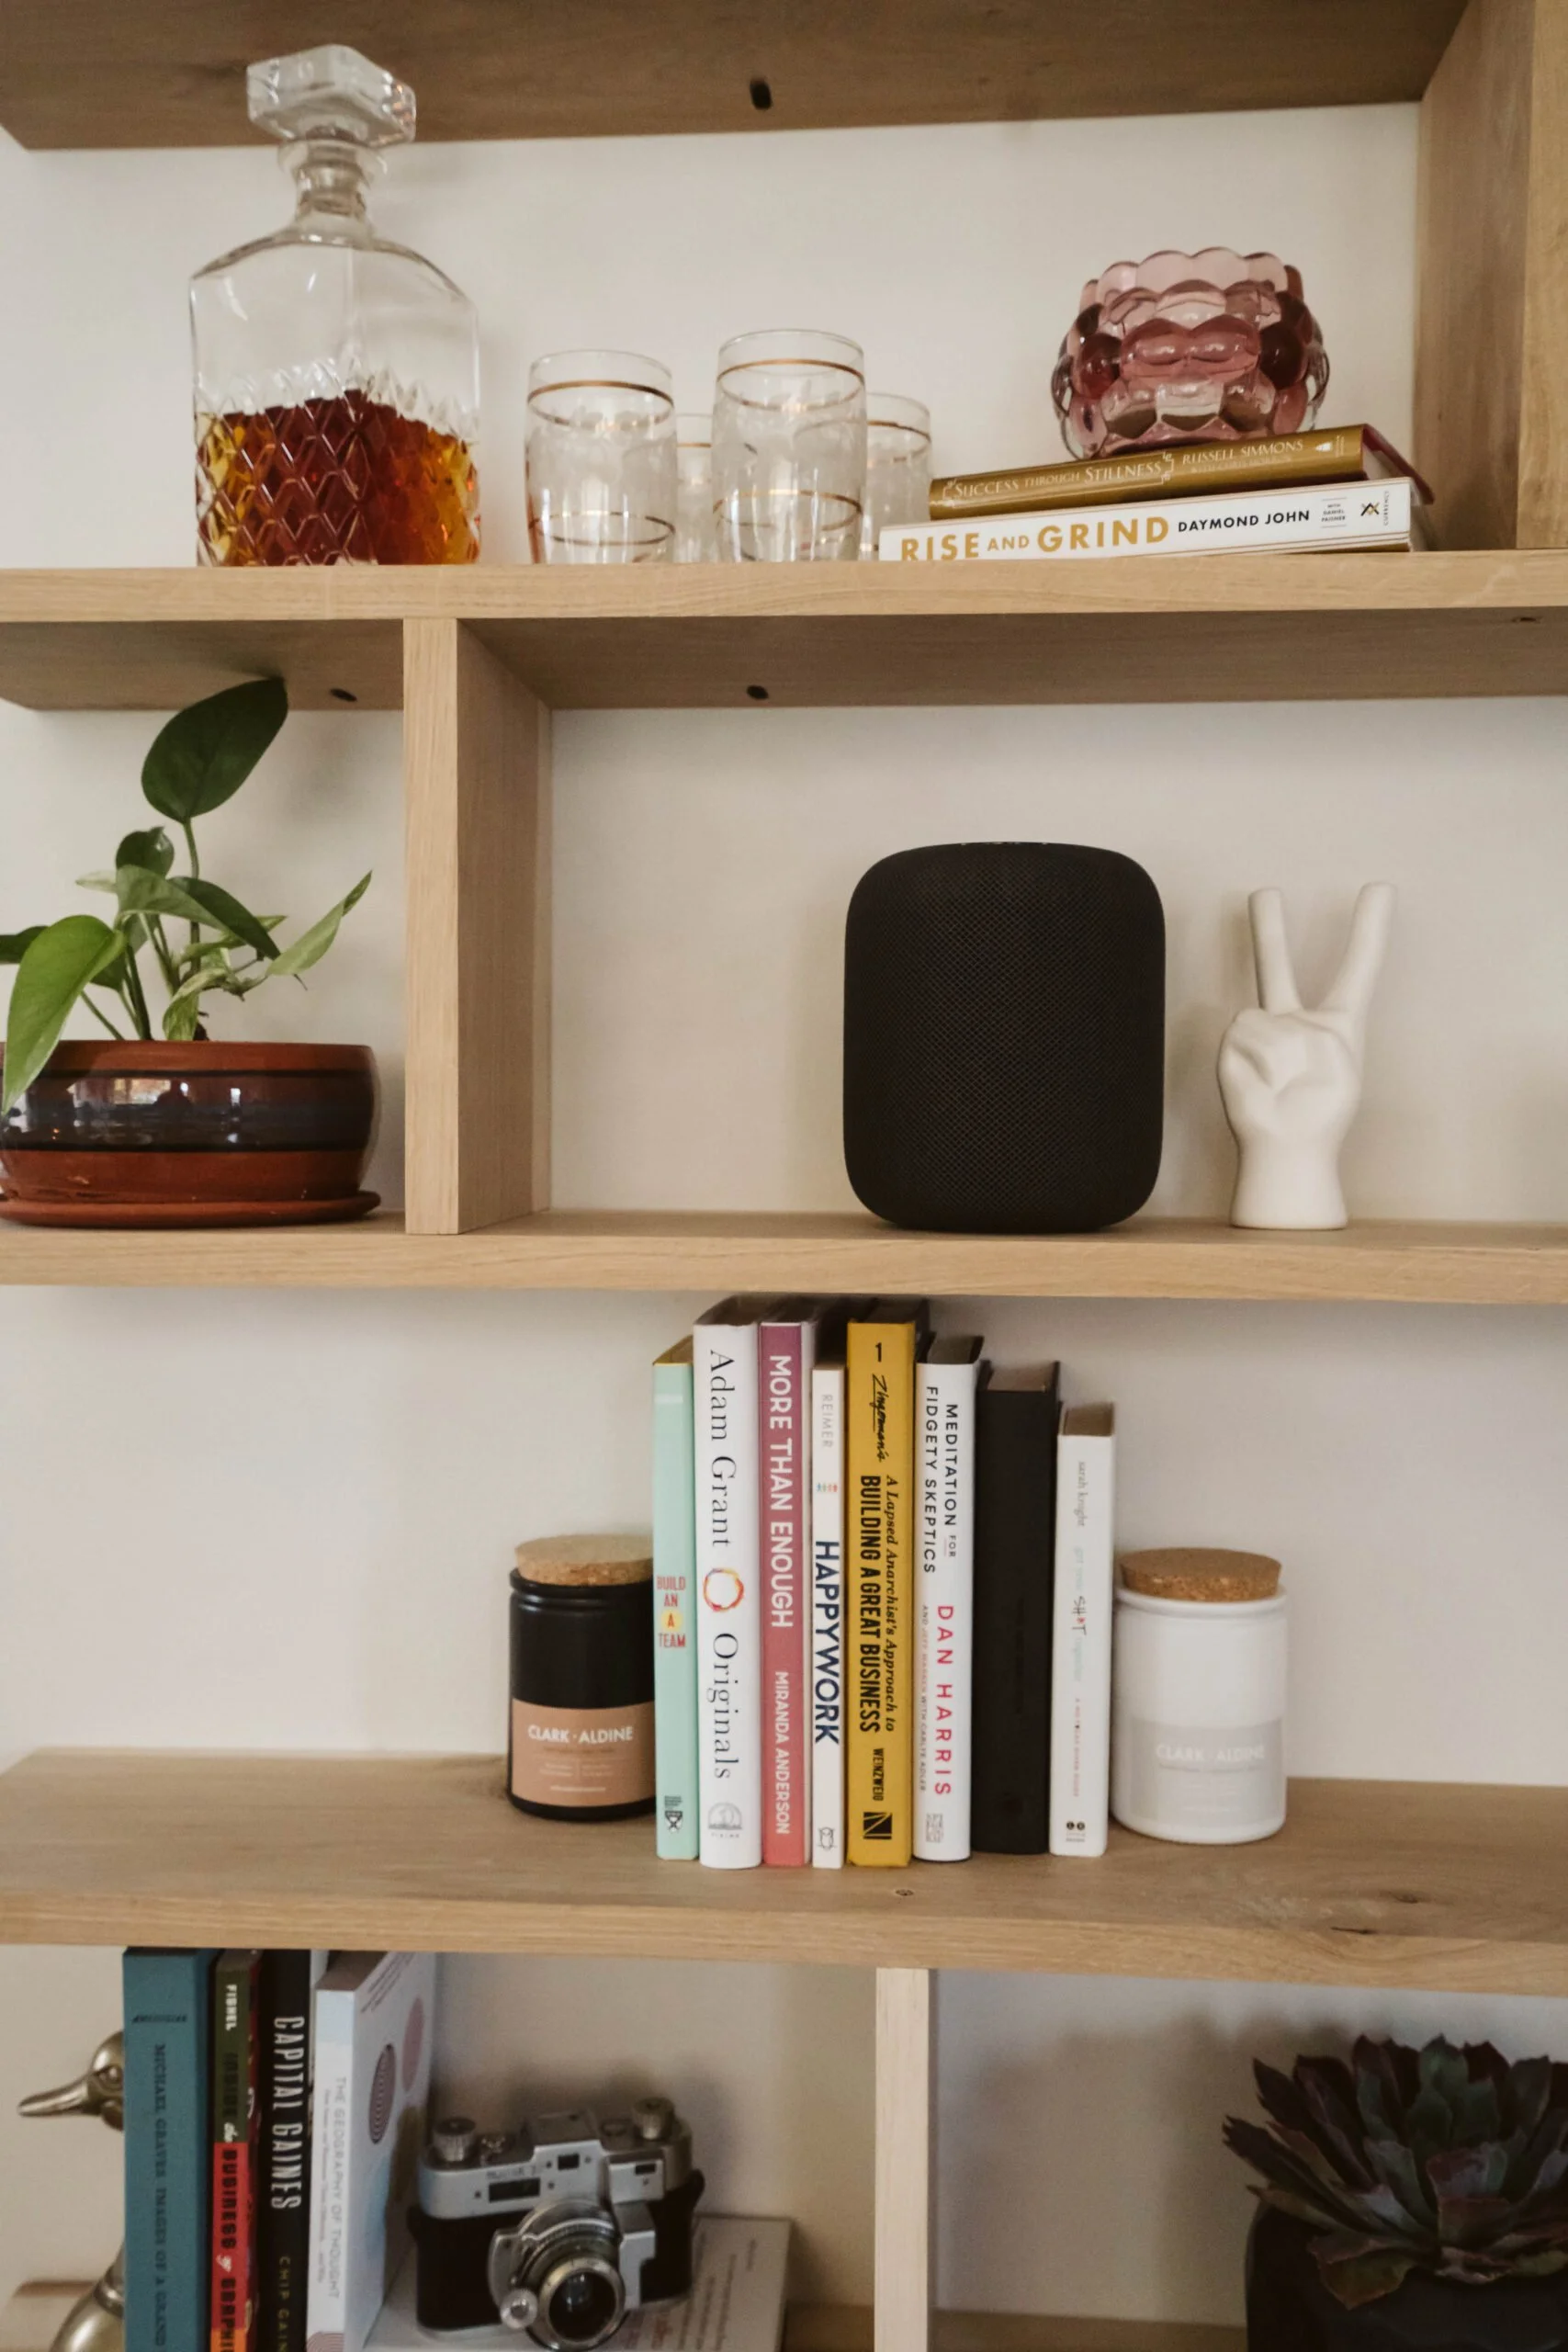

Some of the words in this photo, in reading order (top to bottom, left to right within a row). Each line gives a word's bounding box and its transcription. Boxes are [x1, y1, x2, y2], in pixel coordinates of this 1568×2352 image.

[955, 479, 1019, 498] SUCCESS
[1024, 472, 1080, 488] THROUGH
[1085, 461, 1162, 484] STILLNESS
[1182, 449, 1235, 465] RUSSELL
[1241, 439, 1304, 458] SIMMONS
[901, 533, 980, 560] RISE
[987, 535, 1030, 551] AND
[1037, 516, 1169, 552] GRIND
[1179, 514, 1259, 533] DAYMOND
[1265, 510, 1310, 525] JOHN
[710, 1350, 735, 1442] Adam
[770, 1355, 793, 1430] MORE
[821, 1394, 834, 1448] REIMER
[925, 1386, 938, 1470] FIDGETY
[770, 1438, 793, 1510] THAN
[886, 1475, 898, 1487] A
[944, 1404, 958, 1525] MEDITATION
[1077, 1461, 1088, 1487] sarah
[711, 1456, 737, 1547] Grant
[861, 1476, 881, 1560] BUILDING
[884, 1490, 898, 1545] Lapsed
[923, 1479, 937, 1573] SKEPTICS
[1074, 1492, 1088, 1526] knight
[770, 1521, 794, 1628] ENOUGH
[861, 1566, 881, 1578] A
[948, 1535, 956, 1557] FOR
[657, 1576, 686, 1591] BUILD
[664, 1593, 678, 1607] AN
[861, 1583, 881, 1638] GREAT
[886, 1548, 899, 1634] Anarchist's
[659, 1634, 686, 1647] TEAM
[667, 1612, 675, 1628] A
[815, 1540, 840, 1745] HAPPYWORK
[937, 1606, 953, 1665] DAN
[860, 1644, 881, 1733] BUSINESS
[883, 1638, 897, 1712] Approach
[527, 1724, 570, 1743] CLARK
[579, 1725, 634, 1744] ALDINE
[707, 1633, 739, 1779] Originals
[774, 1671, 790, 1744] MIRANDA
[886, 1717, 897, 1732] to
[934, 1684, 953, 1795] HARRIS
[1156, 1744, 1205, 1761] CLARK
[774, 1747, 790, 1834] ANDERSON
[873, 1747, 885, 1802] WEINZWEIG
[154, 2042, 167, 2113] MICHAEL
[273, 2016, 305, 2110] CAPITAL
[334, 2076, 347, 2104] THE
[154, 2118, 167, 2178] GRAVES
[270, 2122, 304, 2209] GAINES
[333, 2108, 345, 2199] GEOGRAPHY
[154, 2188, 167, 2245] IMAGES
[221, 2149, 237, 2250] BUSINESS
[331, 2204, 343, 2221] OF
[154, 2250, 167, 2271] OF
[278, 2256, 290, 2300] CHIP
[328, 2228, 342, 2299] THOUGHT
